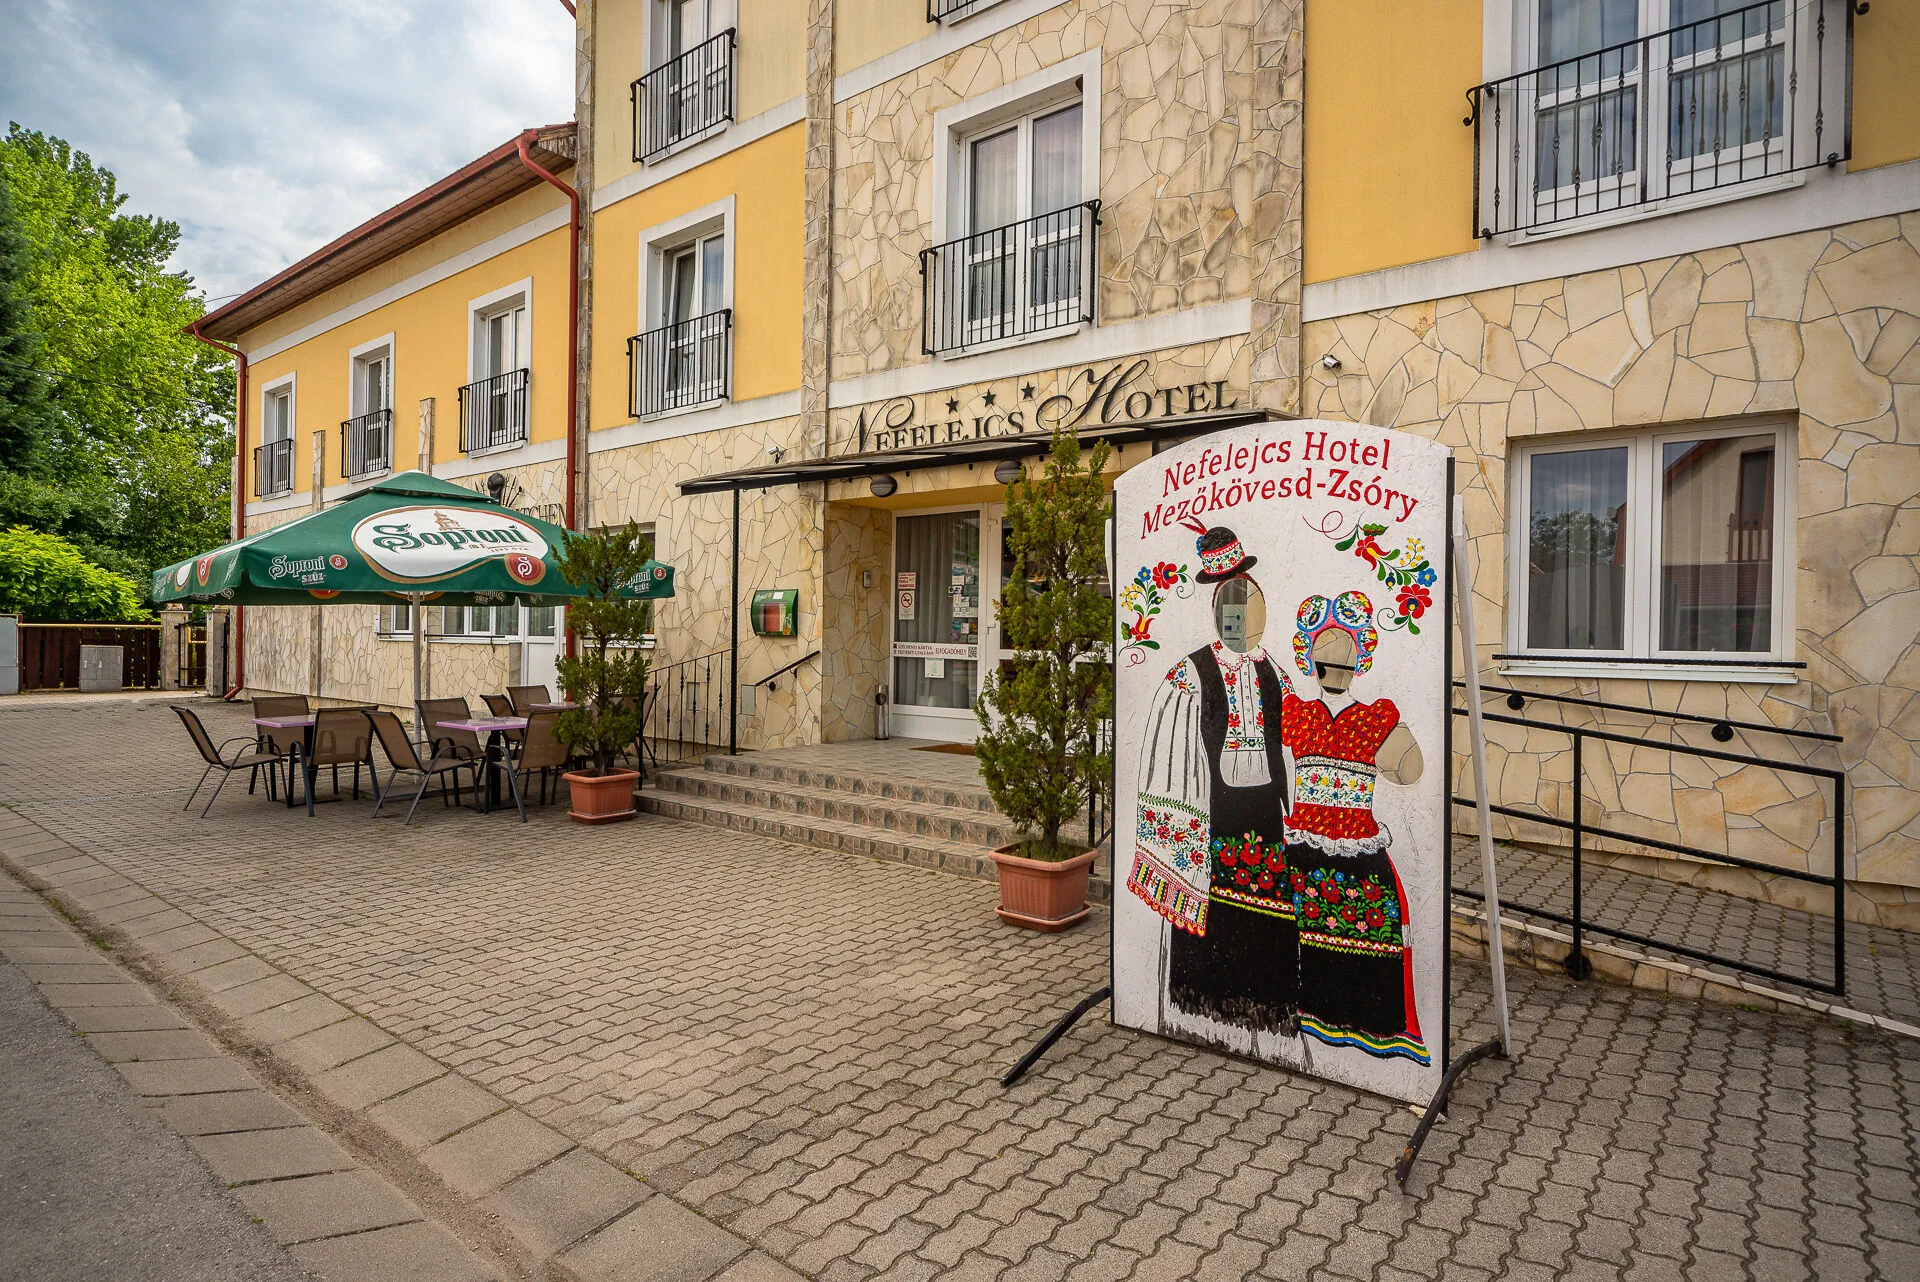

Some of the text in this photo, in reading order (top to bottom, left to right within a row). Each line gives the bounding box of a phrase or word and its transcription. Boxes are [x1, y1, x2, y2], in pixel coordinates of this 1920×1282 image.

[1036, 359, 1239, 430] HOTEL
[1162, 431, 1390, 498] Nefelejcs Hotel
[1140, 466, 1420, 540] Mezőkövesd-Zsóry
[268, 554, 326, 580] Soproni
[371, 522, 534, 555] Soproni
